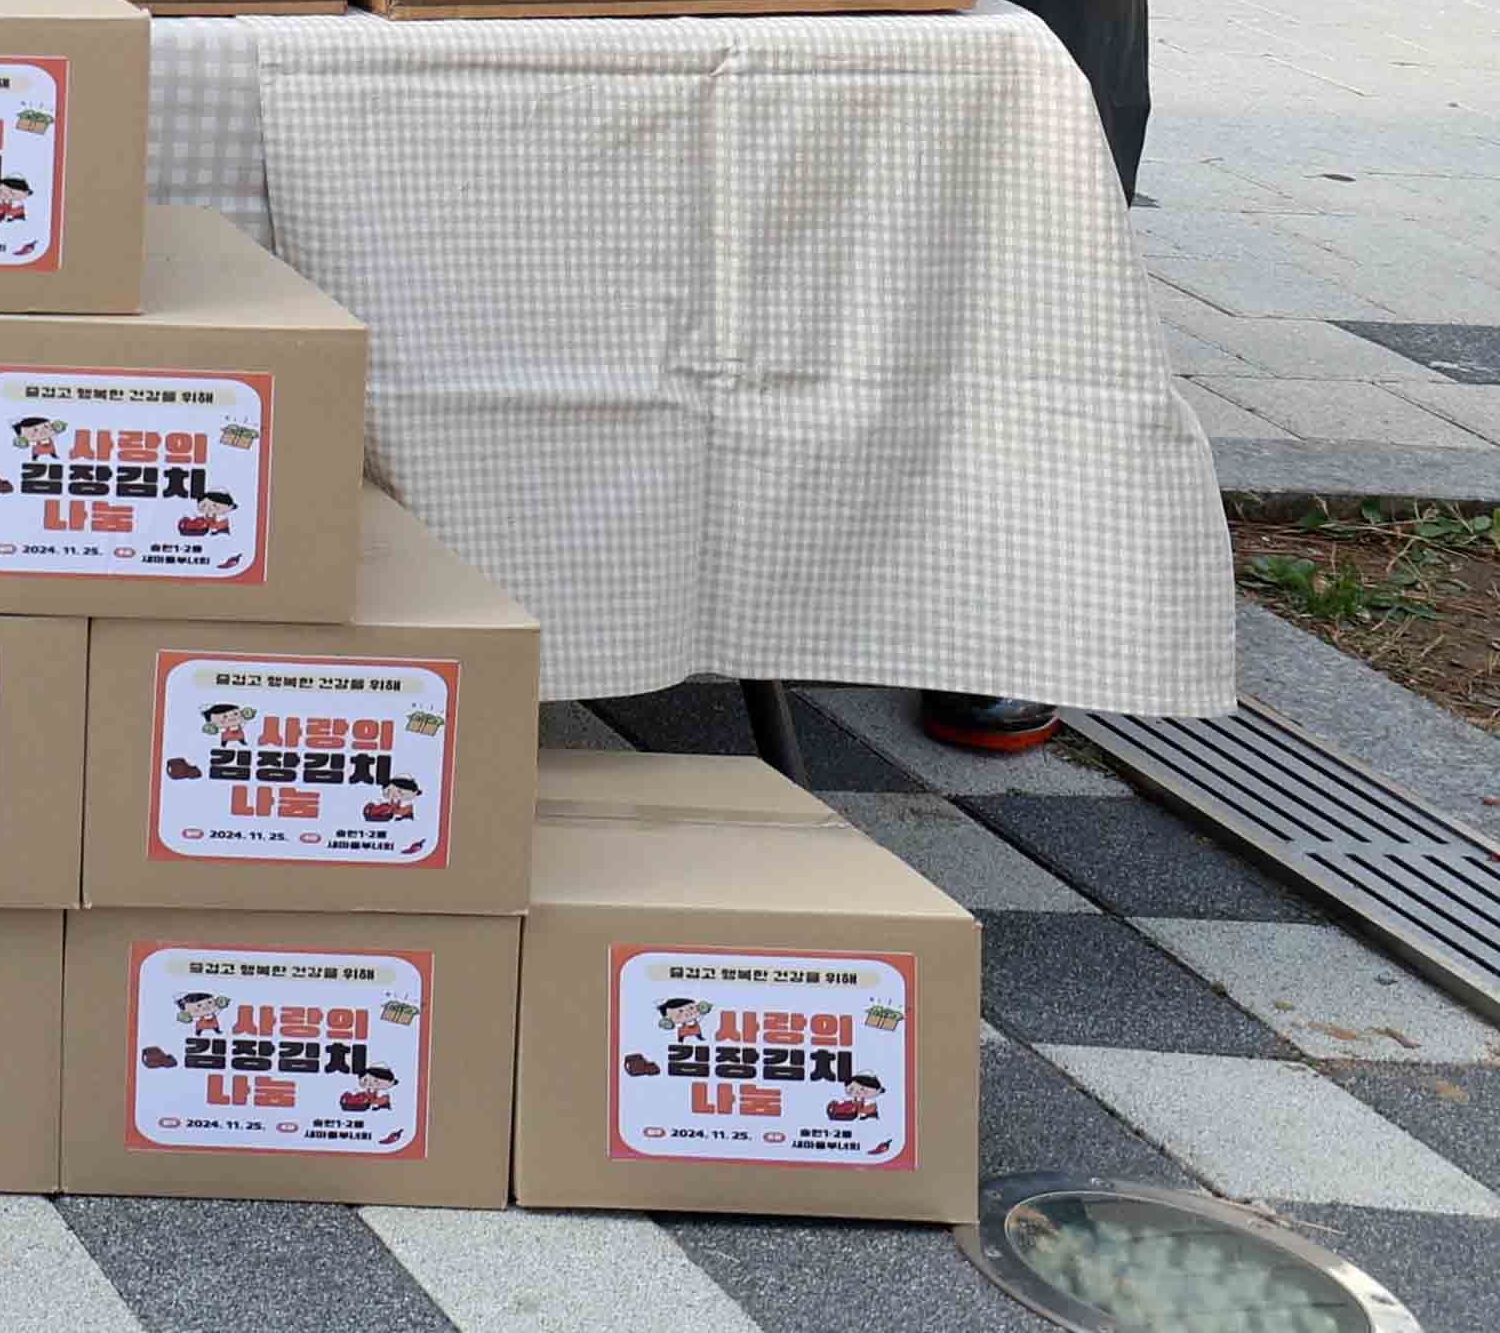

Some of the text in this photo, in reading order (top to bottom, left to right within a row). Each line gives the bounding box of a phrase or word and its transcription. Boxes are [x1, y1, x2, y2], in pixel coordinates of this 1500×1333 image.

[69, 429, 207, 463] 사랑의
[20, 462, 206, 499] 김장김치
[43, 499, 134, 532] 나눔
[824, 972, 857, 985] 위해
[715, 1010, 853, 1046] 사랑의
[668, 1044, 852, 1083] 김장김치
[692, 1082, 781, 1116] 나눔
